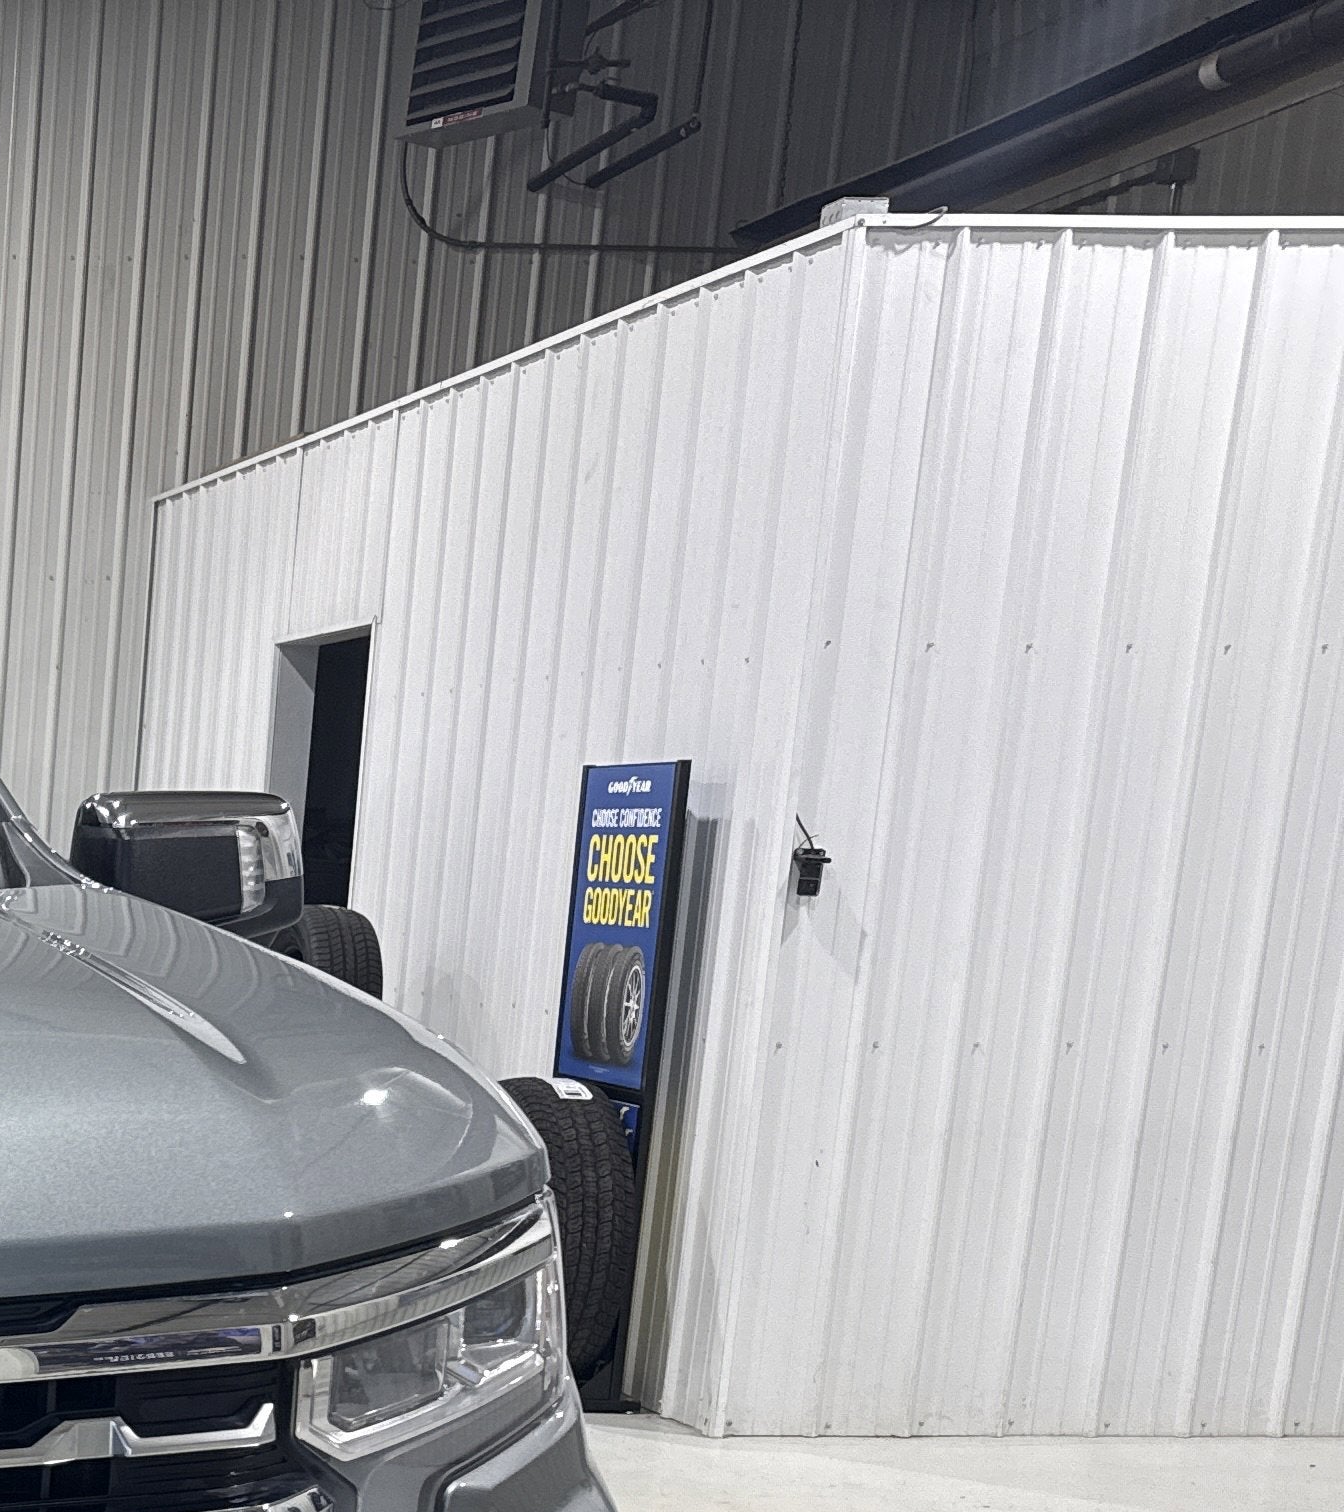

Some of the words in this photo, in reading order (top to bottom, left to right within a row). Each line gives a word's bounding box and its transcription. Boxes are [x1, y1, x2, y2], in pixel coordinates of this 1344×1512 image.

[608, 776, 652, 796] GOODYEAR
[592, 809, 619, 828] CHOOSE
[619, 808, 662, 828] CONFIDENCE
[587, 833, 659, 884] CHOOSE
[583, 886, 653, 929] GOODYEAR
